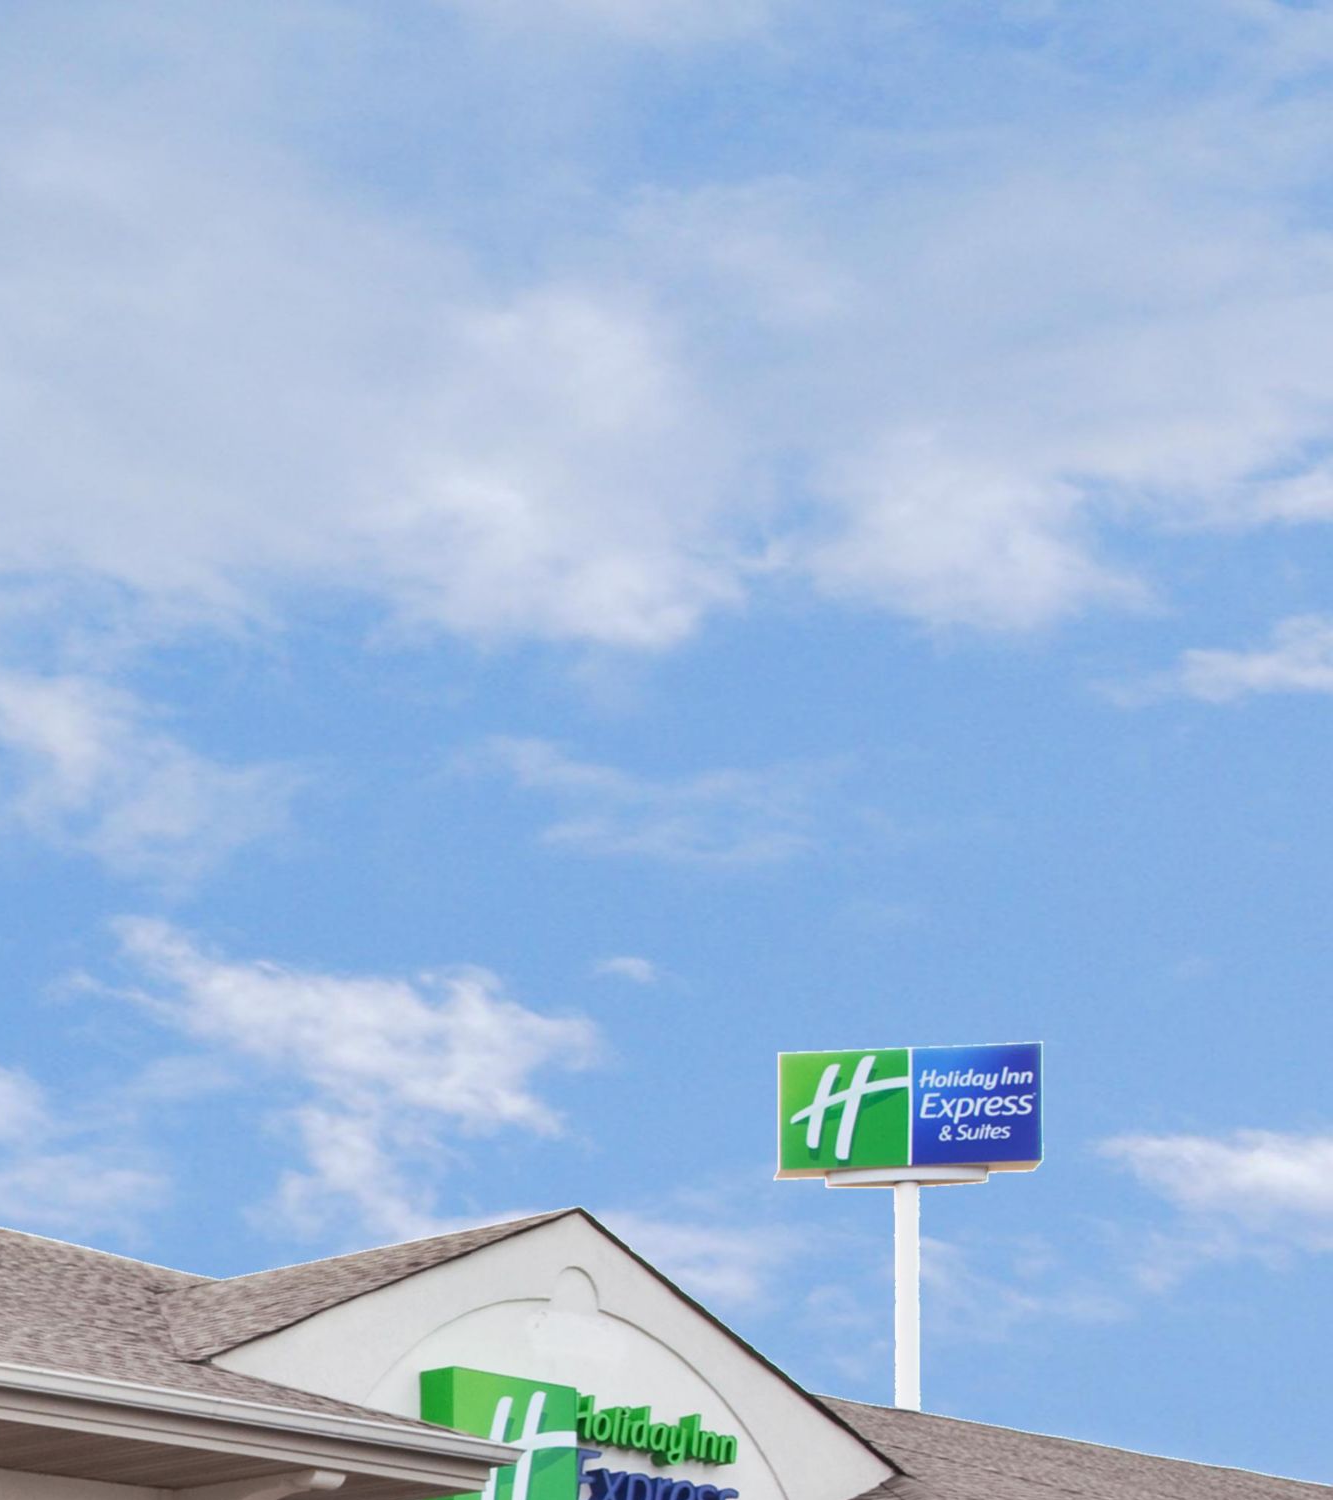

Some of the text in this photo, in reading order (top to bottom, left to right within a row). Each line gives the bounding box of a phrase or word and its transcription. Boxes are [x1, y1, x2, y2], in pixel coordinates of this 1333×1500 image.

[919, 1066, 1033, 1090] Holiday Inn
[919, 1092, 1034, 1124] Express
[938, 1123, 1011, 1142] & Suites
[577, 1393, 737, 1466] Holiday Inn
